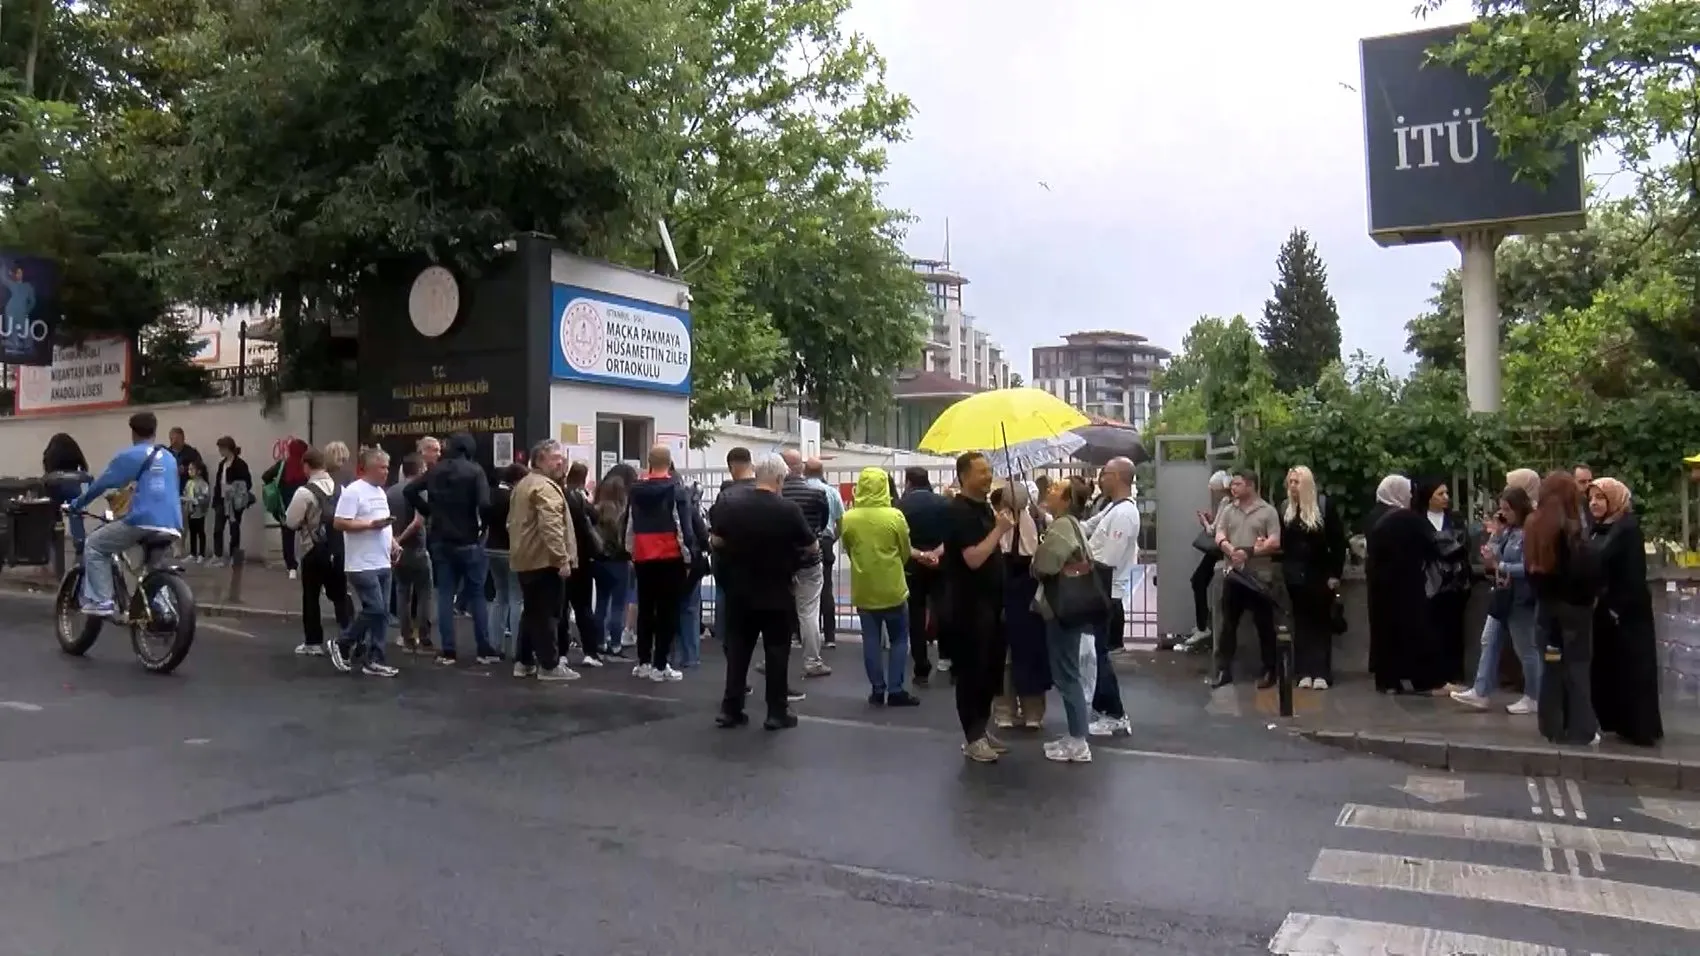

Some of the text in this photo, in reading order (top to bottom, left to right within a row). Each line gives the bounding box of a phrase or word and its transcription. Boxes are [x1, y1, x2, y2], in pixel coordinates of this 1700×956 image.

[1393, 107, 1480, 170] İTÜ
[606, 321, 680, 348] MAÇKA PAKMAYA
[606, 337, 688, 366] HÜSAMETTİN ZİLER
[606, 358, 660, 378] ORTAOKULU
